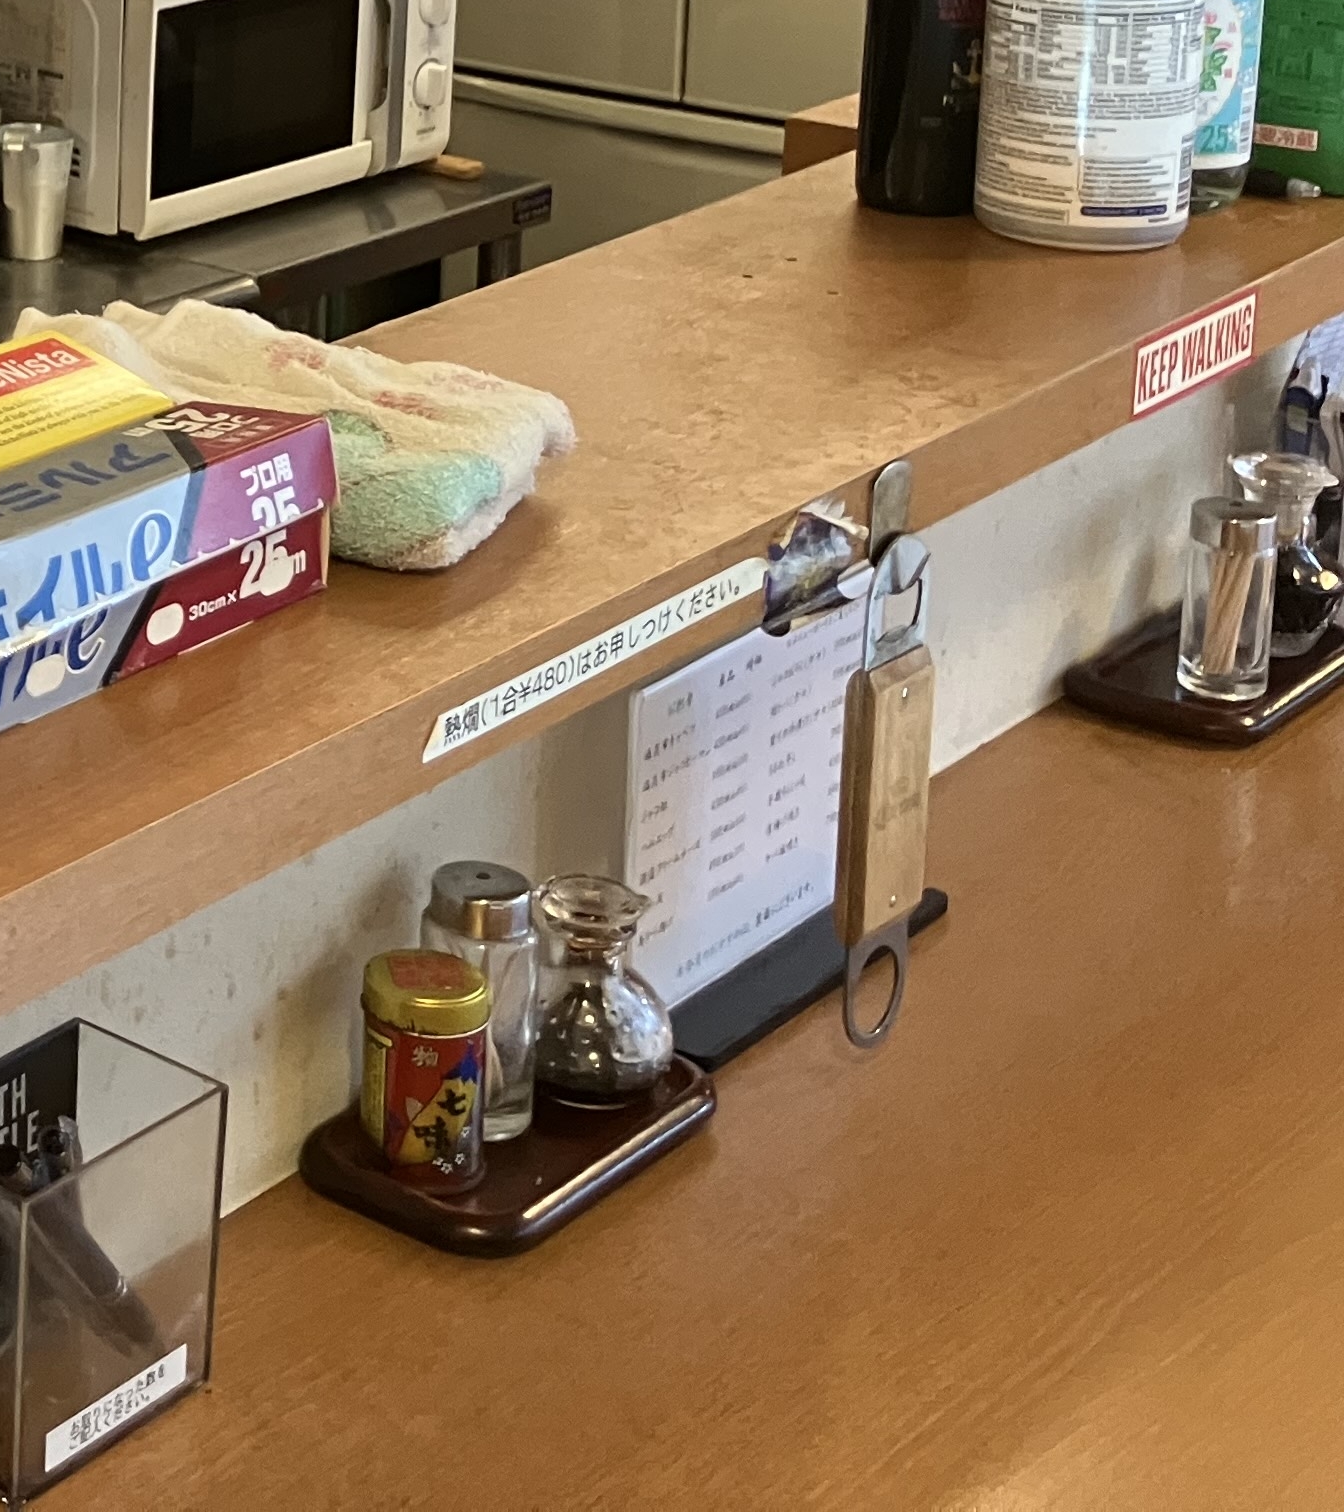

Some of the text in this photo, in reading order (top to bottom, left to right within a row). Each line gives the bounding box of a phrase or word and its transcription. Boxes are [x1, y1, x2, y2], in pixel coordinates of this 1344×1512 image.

[1137, 302, 1253, 405] KEEP WALKING
[240, 452, 294, 497] プロ用
